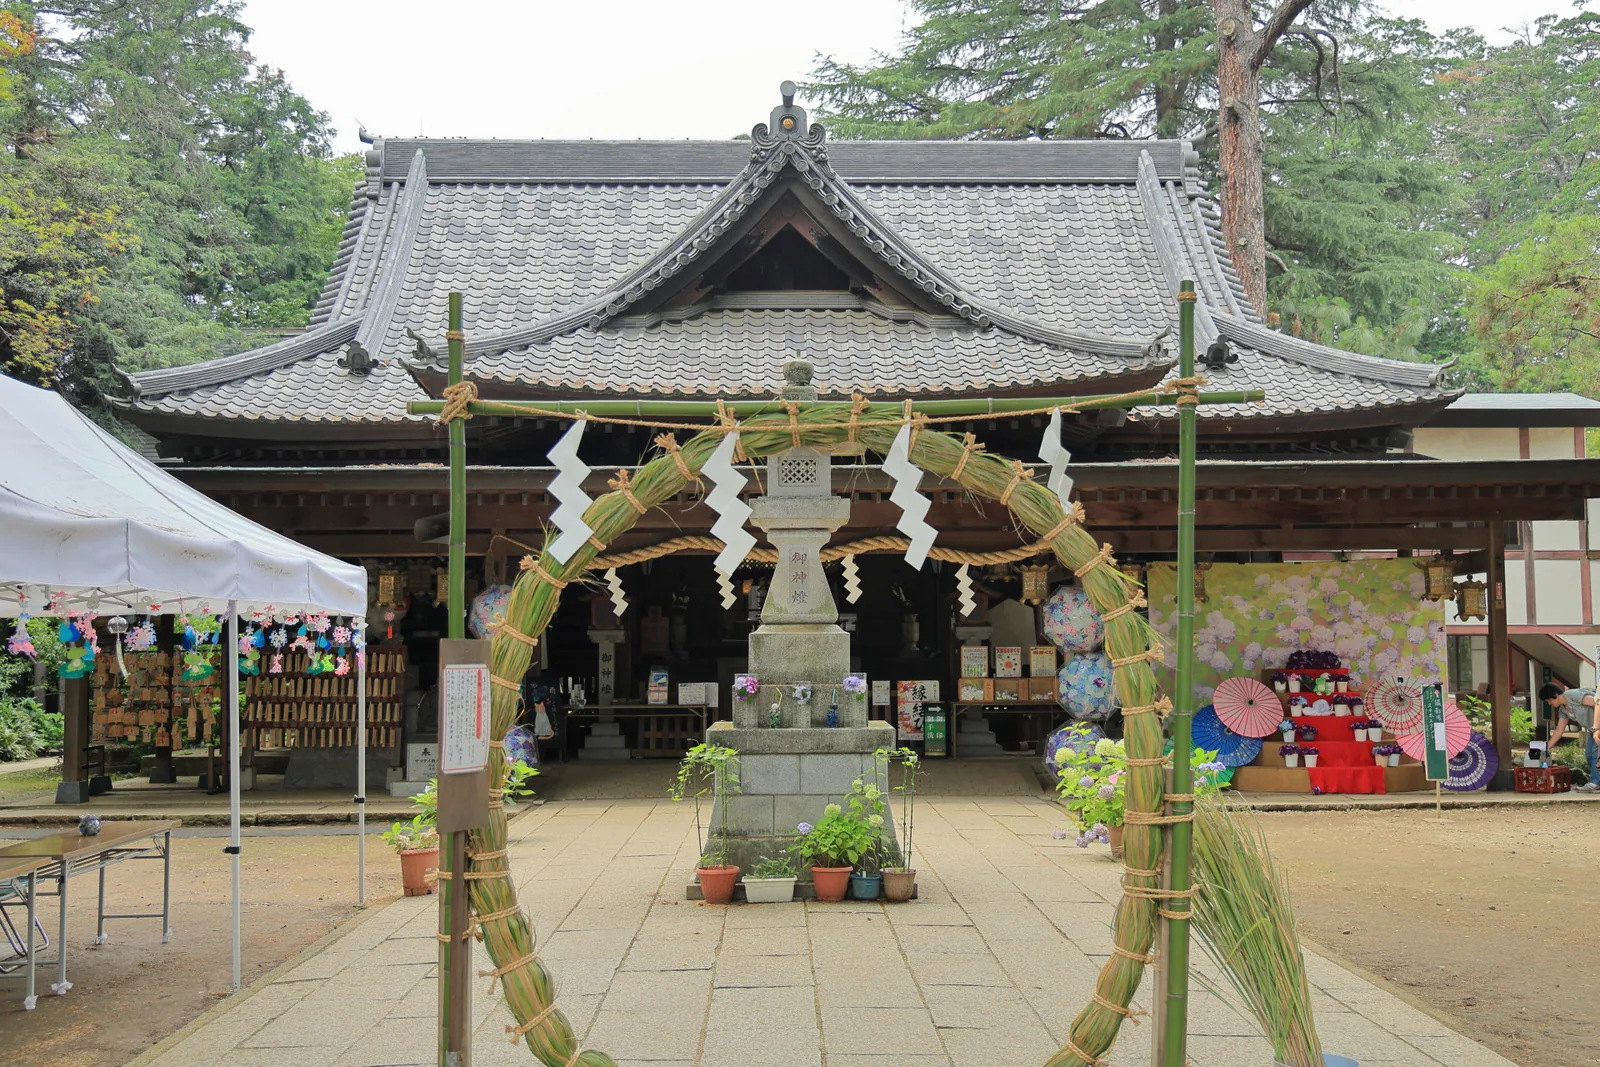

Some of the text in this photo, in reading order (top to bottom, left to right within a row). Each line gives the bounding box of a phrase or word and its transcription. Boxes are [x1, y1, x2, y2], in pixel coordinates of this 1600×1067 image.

[791, 551, 808, 605] 御神燈
[601, 653, 612, 695] 御神燈
